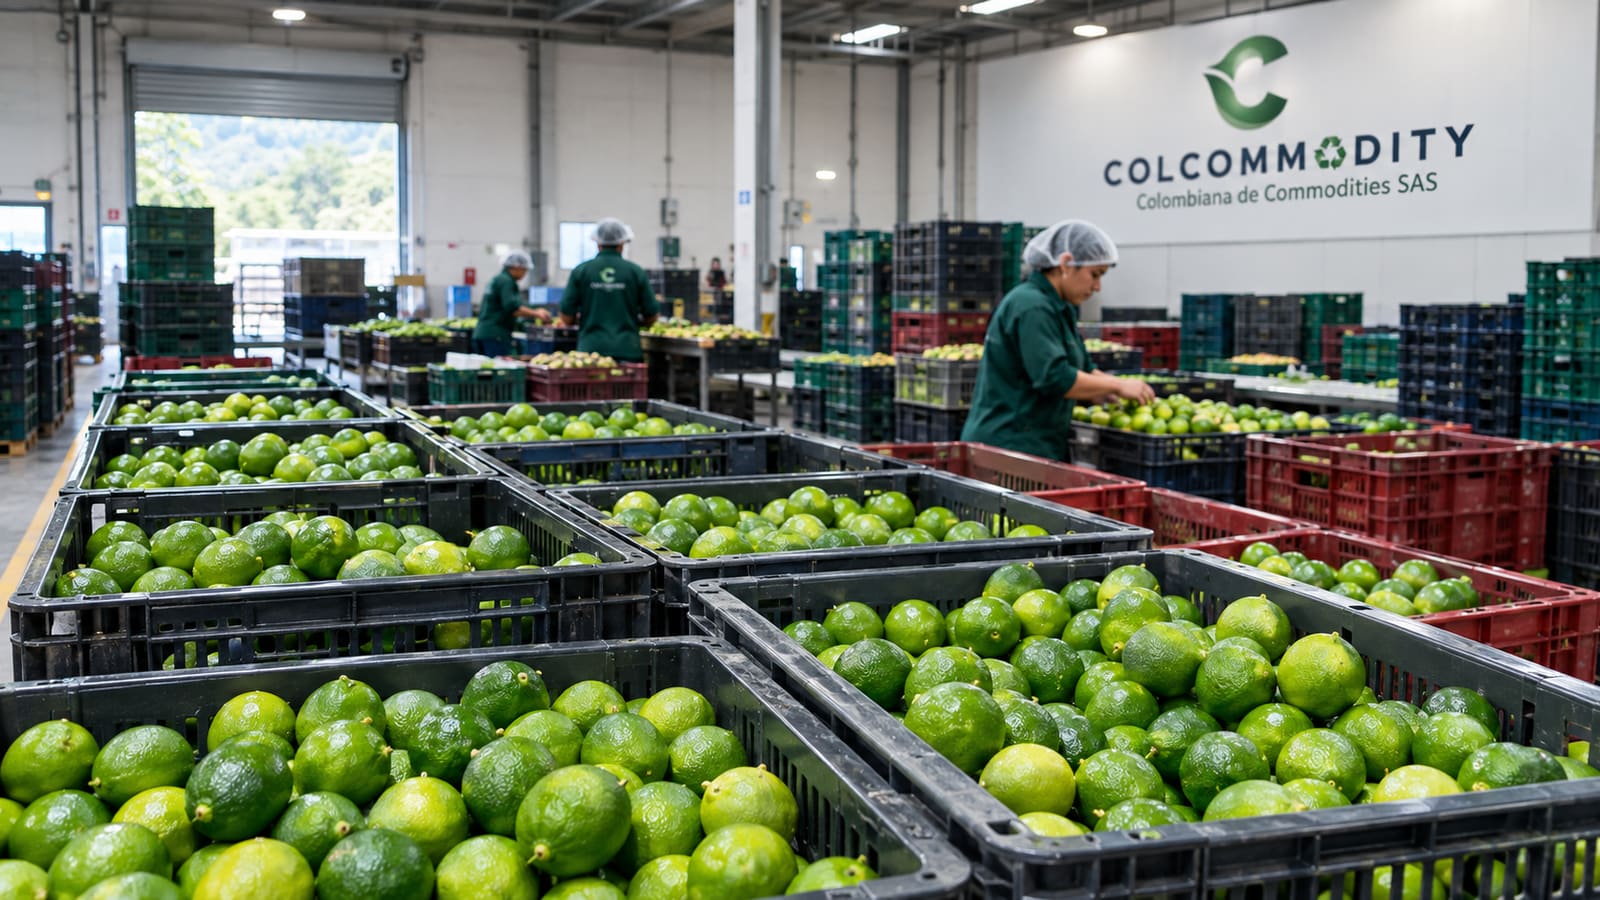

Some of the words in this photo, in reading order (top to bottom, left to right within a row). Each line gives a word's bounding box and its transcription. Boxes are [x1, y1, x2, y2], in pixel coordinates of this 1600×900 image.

[1136, 189, 1233, 210] Colombiana
[1237, 186, 1259, 204] de
[1264, 177, 1391, 202] Commodities
[1397, 172, 1439, 194] SAS
